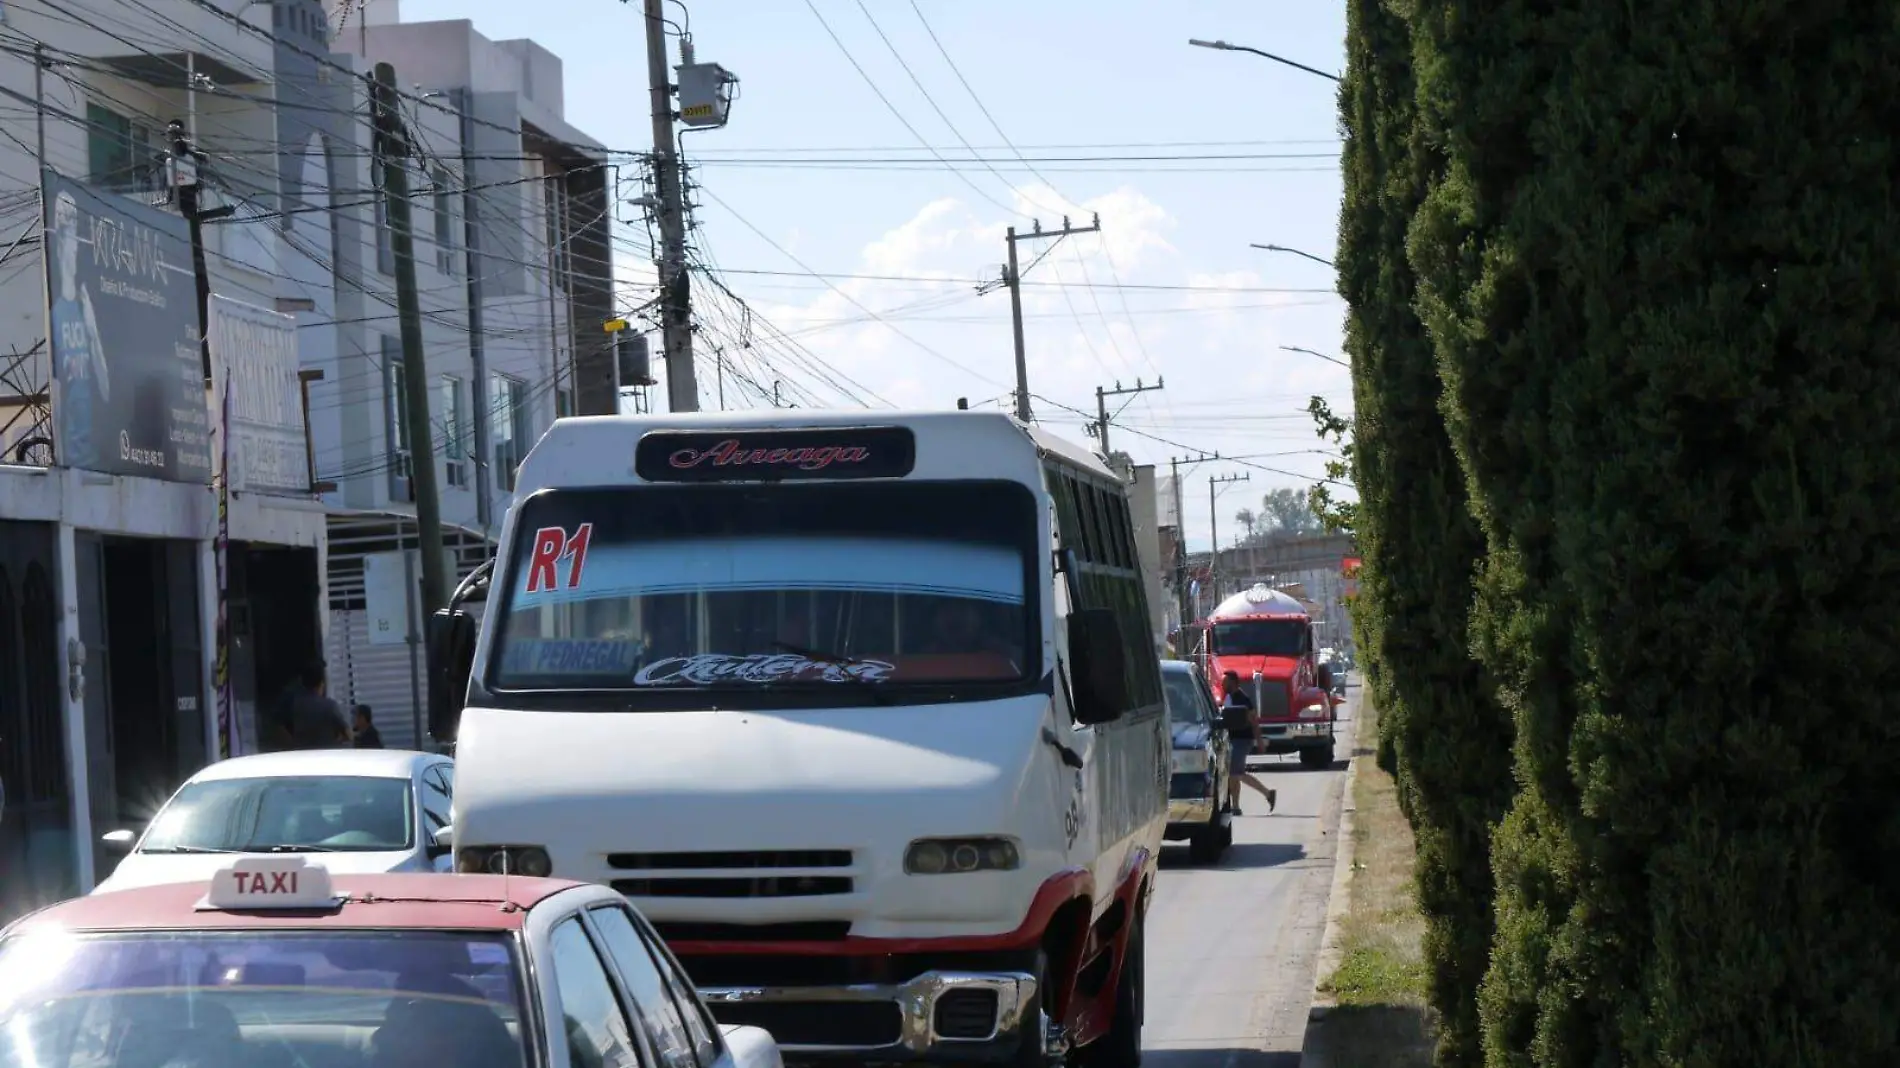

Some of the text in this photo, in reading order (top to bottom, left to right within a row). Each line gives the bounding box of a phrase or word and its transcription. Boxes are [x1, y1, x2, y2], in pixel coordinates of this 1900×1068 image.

[669, 439, 869, 470] Arreaga
[525, 523, 592, 592] R1
[537, 641, 630, 672] PEDREGAL
[233, 871, 298, 894] TAXI
